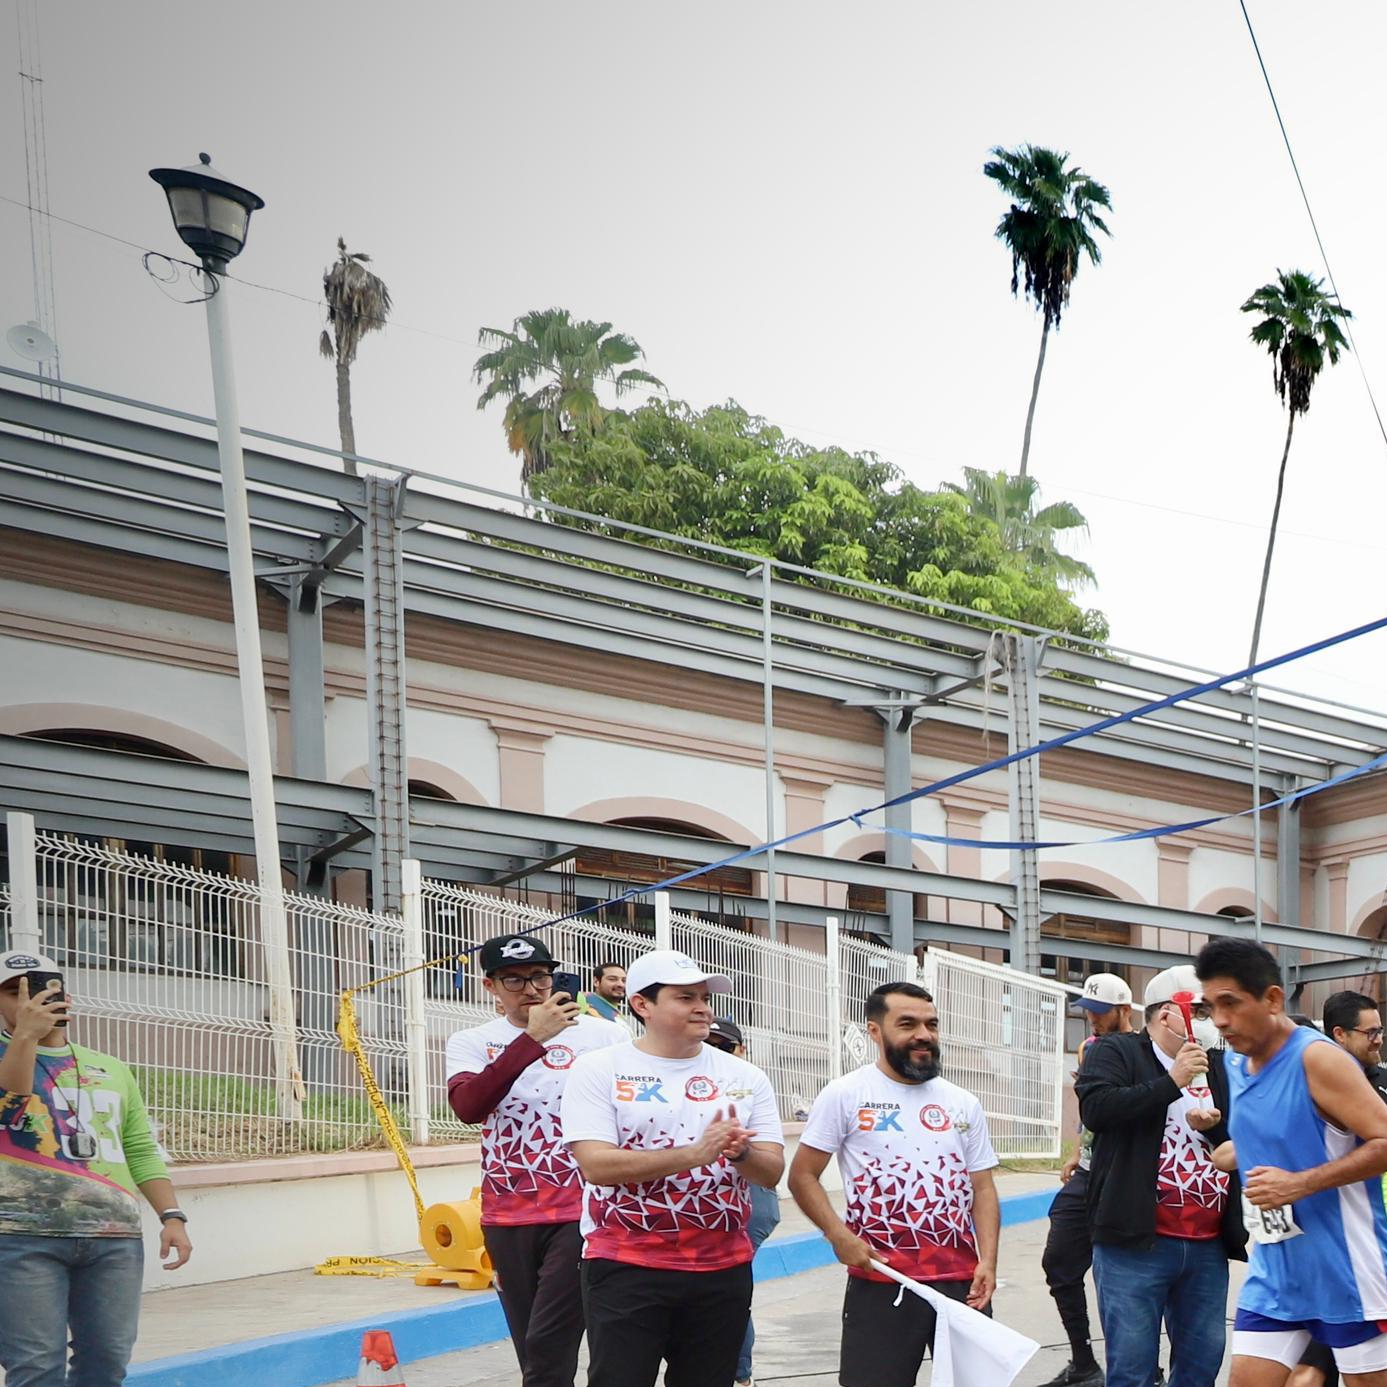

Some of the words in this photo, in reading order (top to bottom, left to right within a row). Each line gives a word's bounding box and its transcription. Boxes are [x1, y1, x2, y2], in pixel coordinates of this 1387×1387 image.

[615, 1073, 662, 1083] CARRERA
[616, 1080, 669, 1103] 5K
[859, 1102, 901, 1110] CARRERA
[858, 1109, 904, 1132] 5K
